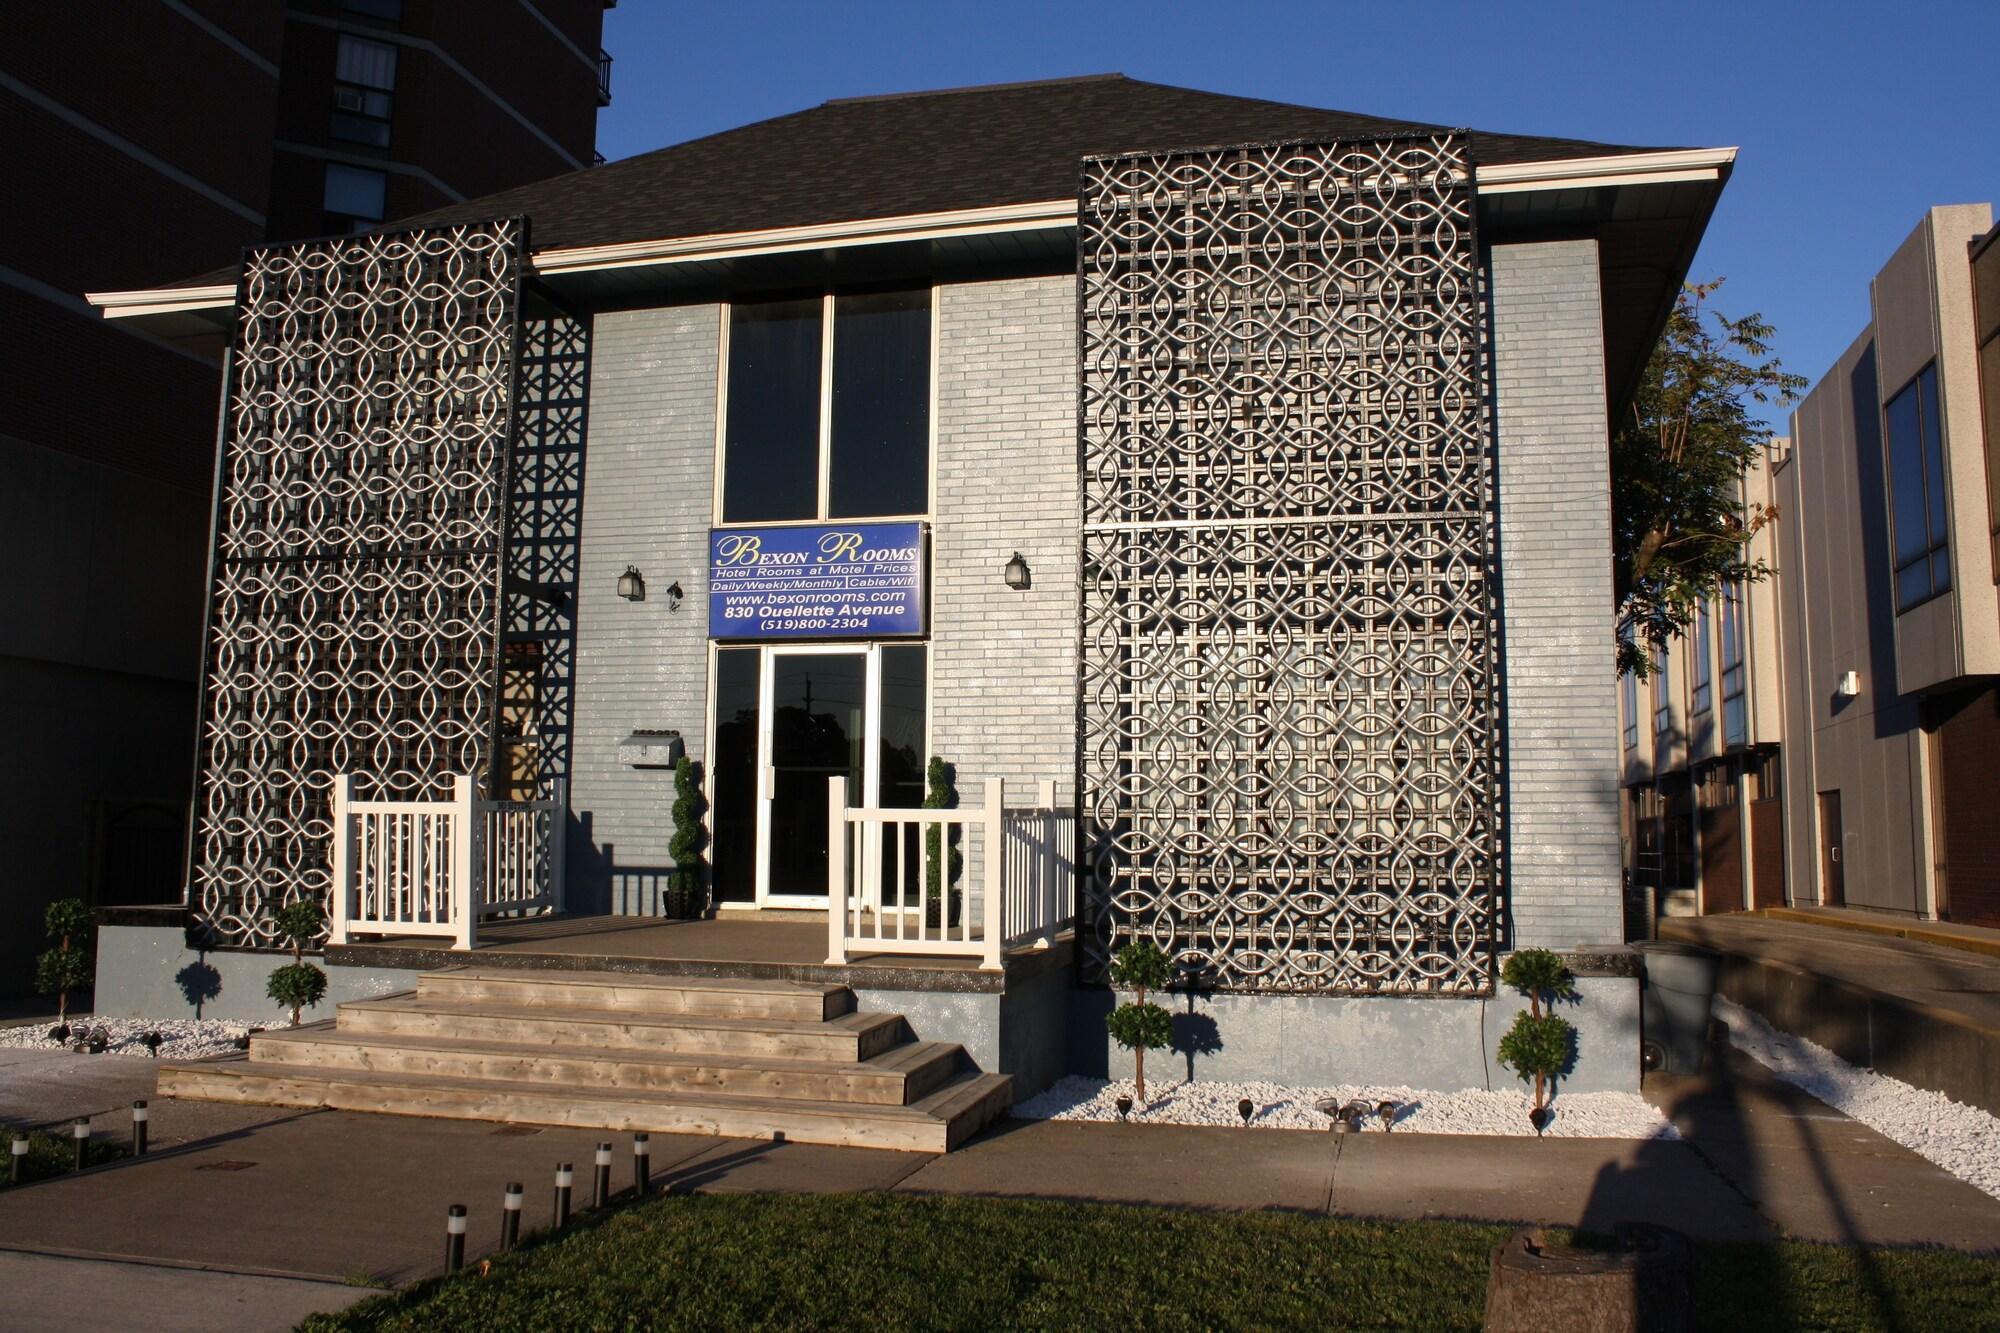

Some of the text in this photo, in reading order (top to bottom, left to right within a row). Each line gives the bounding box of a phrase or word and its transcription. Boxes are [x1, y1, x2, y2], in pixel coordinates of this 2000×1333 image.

[716, 532, 917, 567] BEXON ROOMS
[716, 563, 917, 578] Hotel Rooms at Motel Prices
[712, 576, 915, 592] Daily/Weekly/Monthly Cable/Wifi
[725, 591, 906, 606] www.bexonrooms.com
[724, 603, 905, 619] 830 Ouellette Avenue
[760, 617, 869, 631] (519)800-2304
